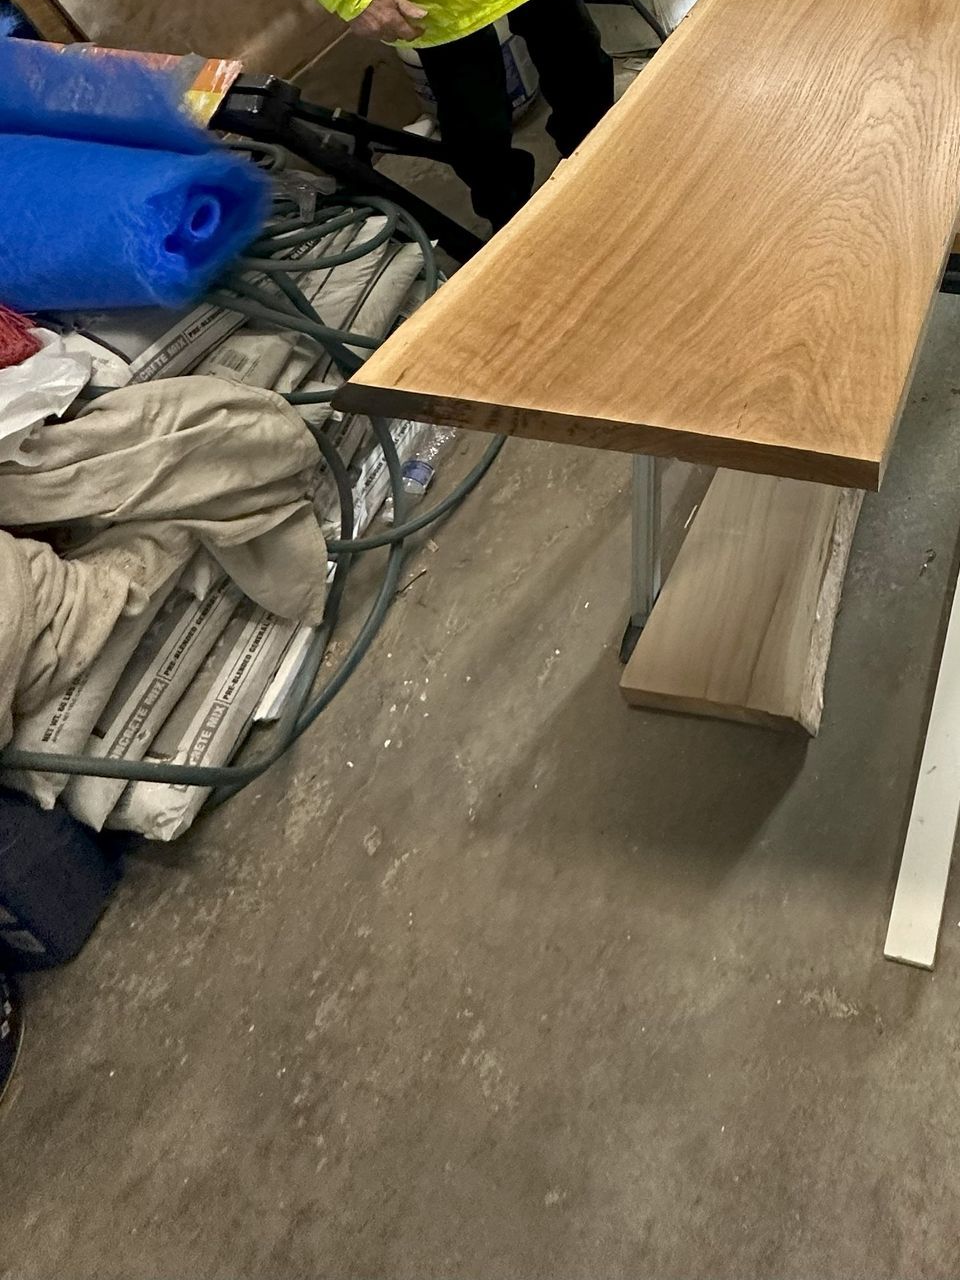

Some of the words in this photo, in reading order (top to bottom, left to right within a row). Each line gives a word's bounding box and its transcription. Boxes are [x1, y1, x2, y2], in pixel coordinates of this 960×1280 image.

[110, 707, 150, 760] ONCRETE
[145, 679, 169, 711] MIX
[163, 626, 198, 676] PRE-BLENDED
[207, 705, 229, 733] MIX
[222, 654, 252, 701] PRE-BLENDED
